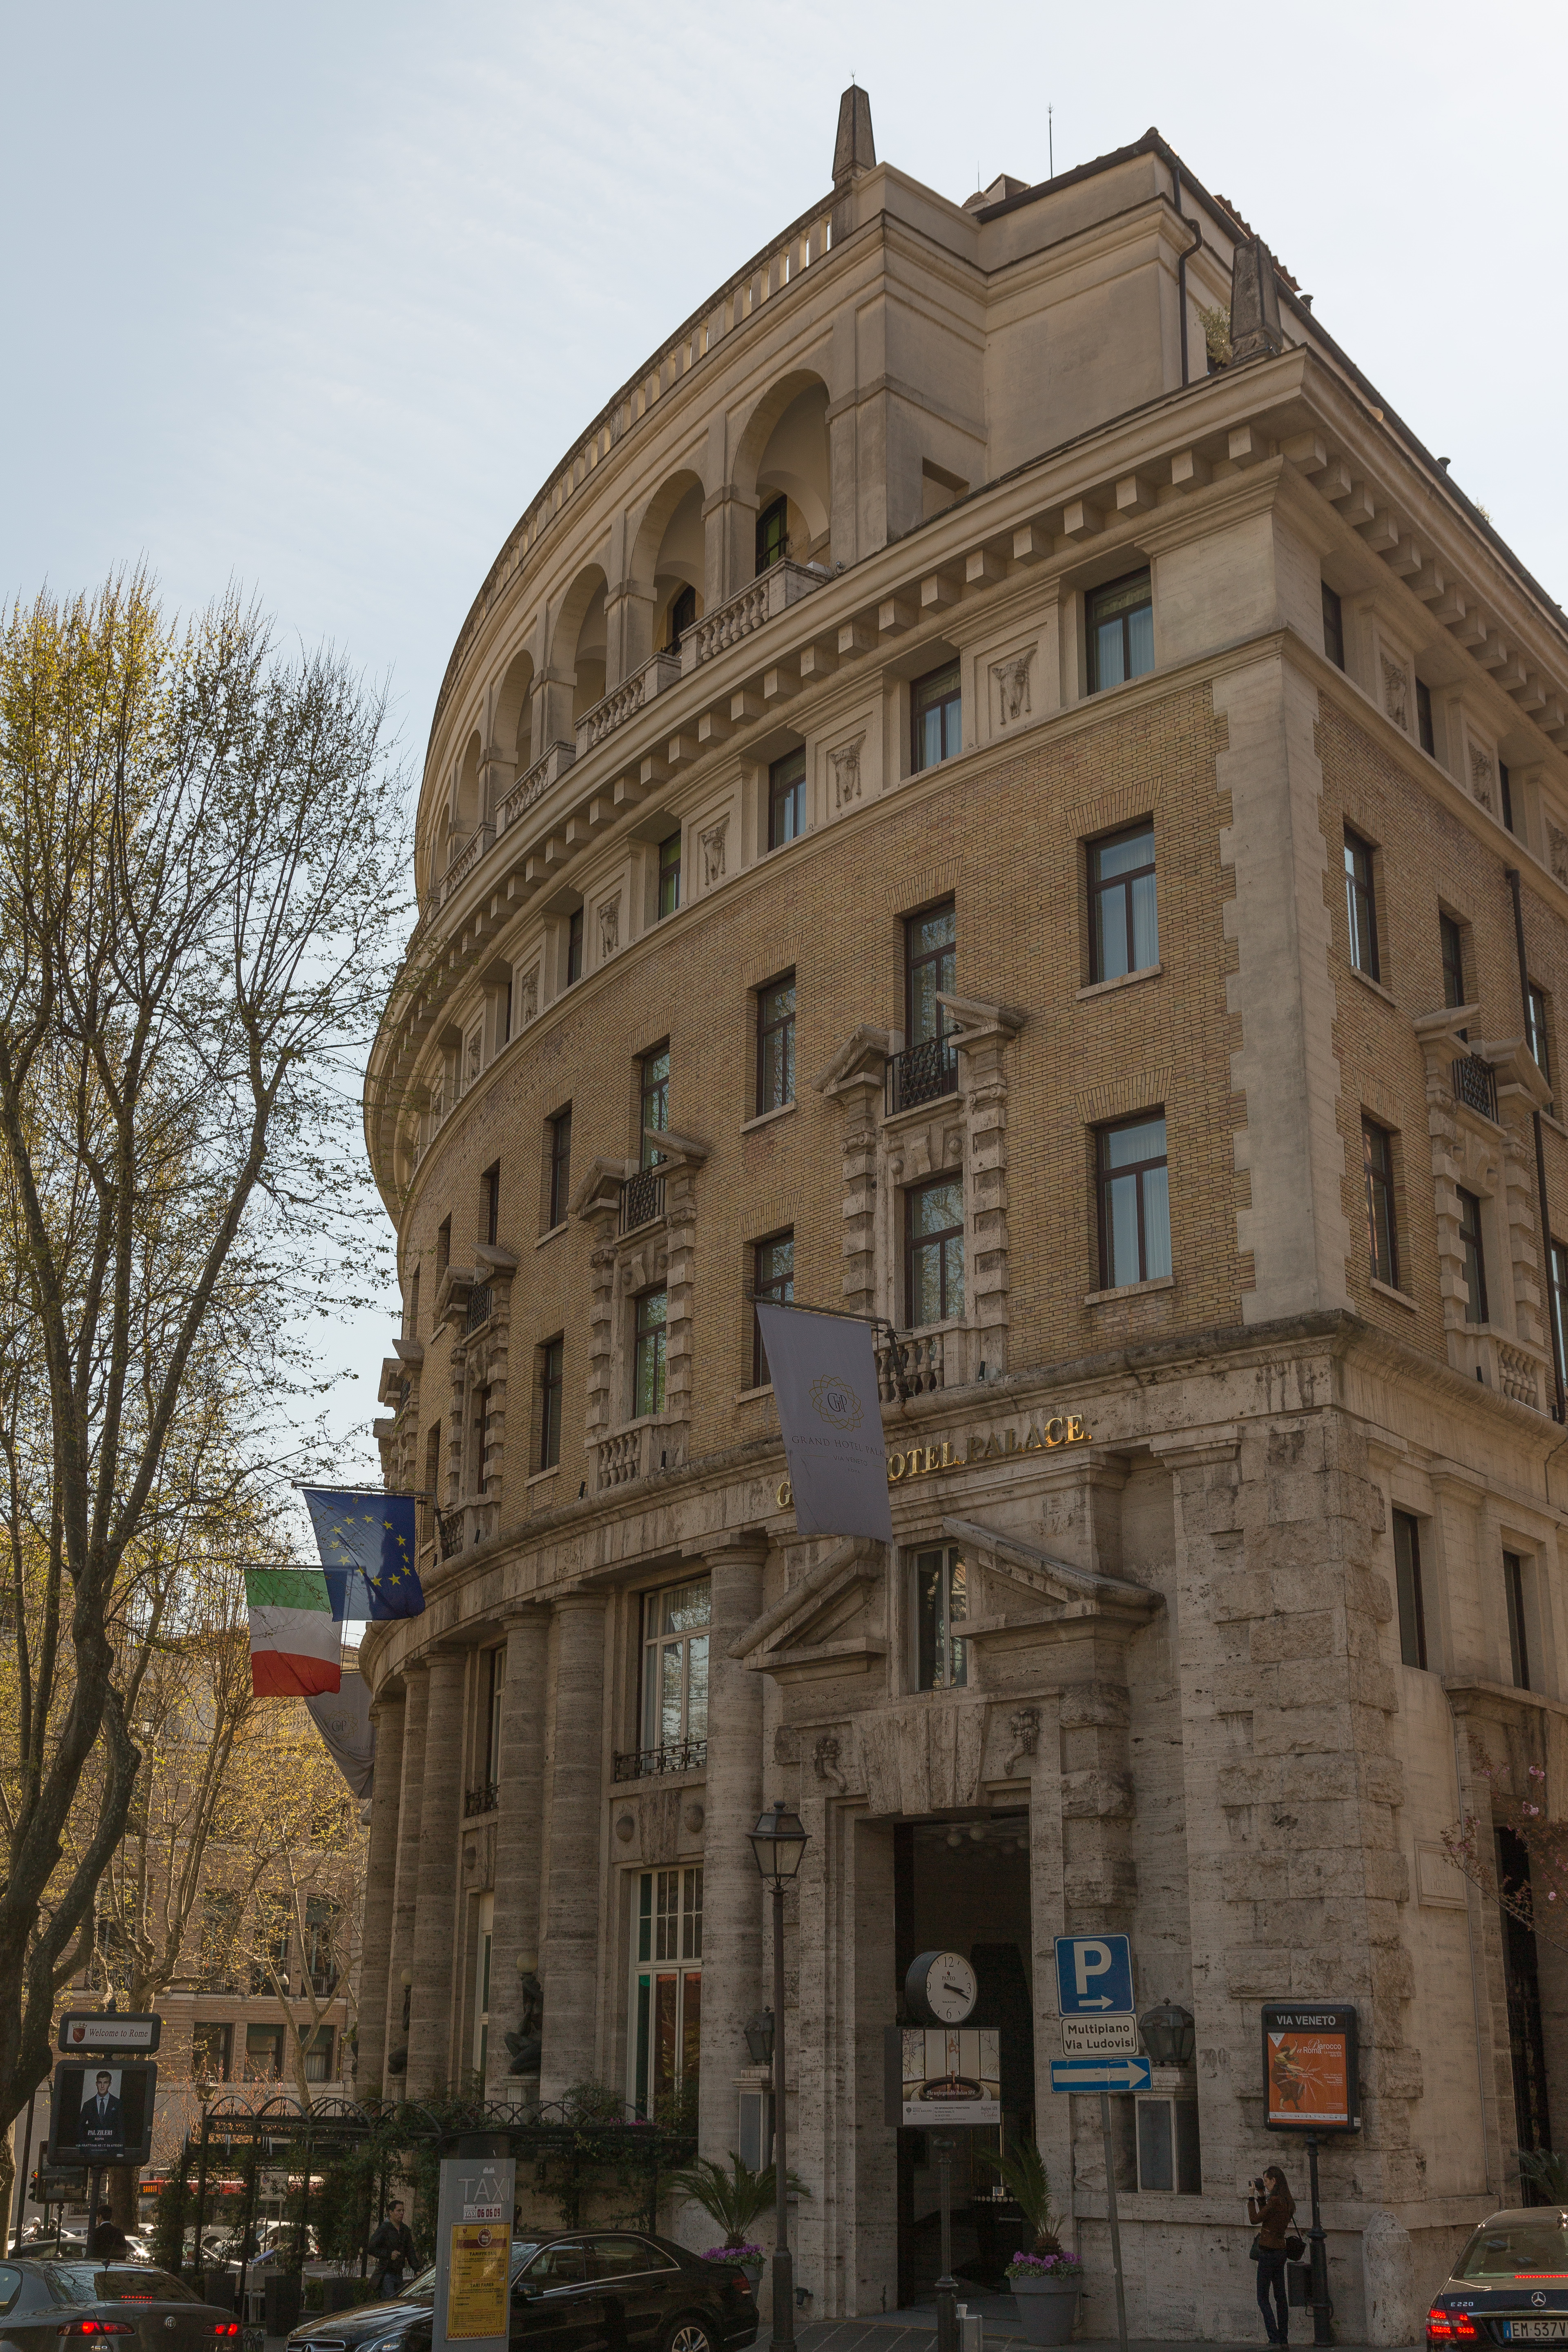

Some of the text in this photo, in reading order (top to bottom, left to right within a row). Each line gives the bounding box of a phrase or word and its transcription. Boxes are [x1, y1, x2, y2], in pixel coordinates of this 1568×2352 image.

[792, 1435, 885, 1458] GRAND HOTEL PALAC
[887, 1414, 1085, 1480] OTEL PALACE
[846, 1456, 868, 1466] VENETO
[943, 1956, 954, 1967] 12
[1073, 1941, 1112, 1994] P
[927, 1982, 931, 1992] 9
[966, 1982, 972, 1993] 3
[946, 2007, 952, 2019] 6
[1276, 2015, 1336, 2025] VIA VENETO
[89, 2028, 119, 2037] Welcome
[129, 2029, 148, 2037] Rome
[1068, 2023, 1130, 2035] Multipiano
[1065, 2037, 1134, 2049] Via Ludovisi
[1308, 2038, 1342, 2049] Barocco
[457, 2177, 510, 2203] TAXI
[477, 2209, 484, 2218] 06
[486, 2208, 493, 2217] 06
[494, 2208, 500, 2217] 09
[1512, 2323, 1528, 2336] EM
[1534, 2322, 1568, 2336] 537V
